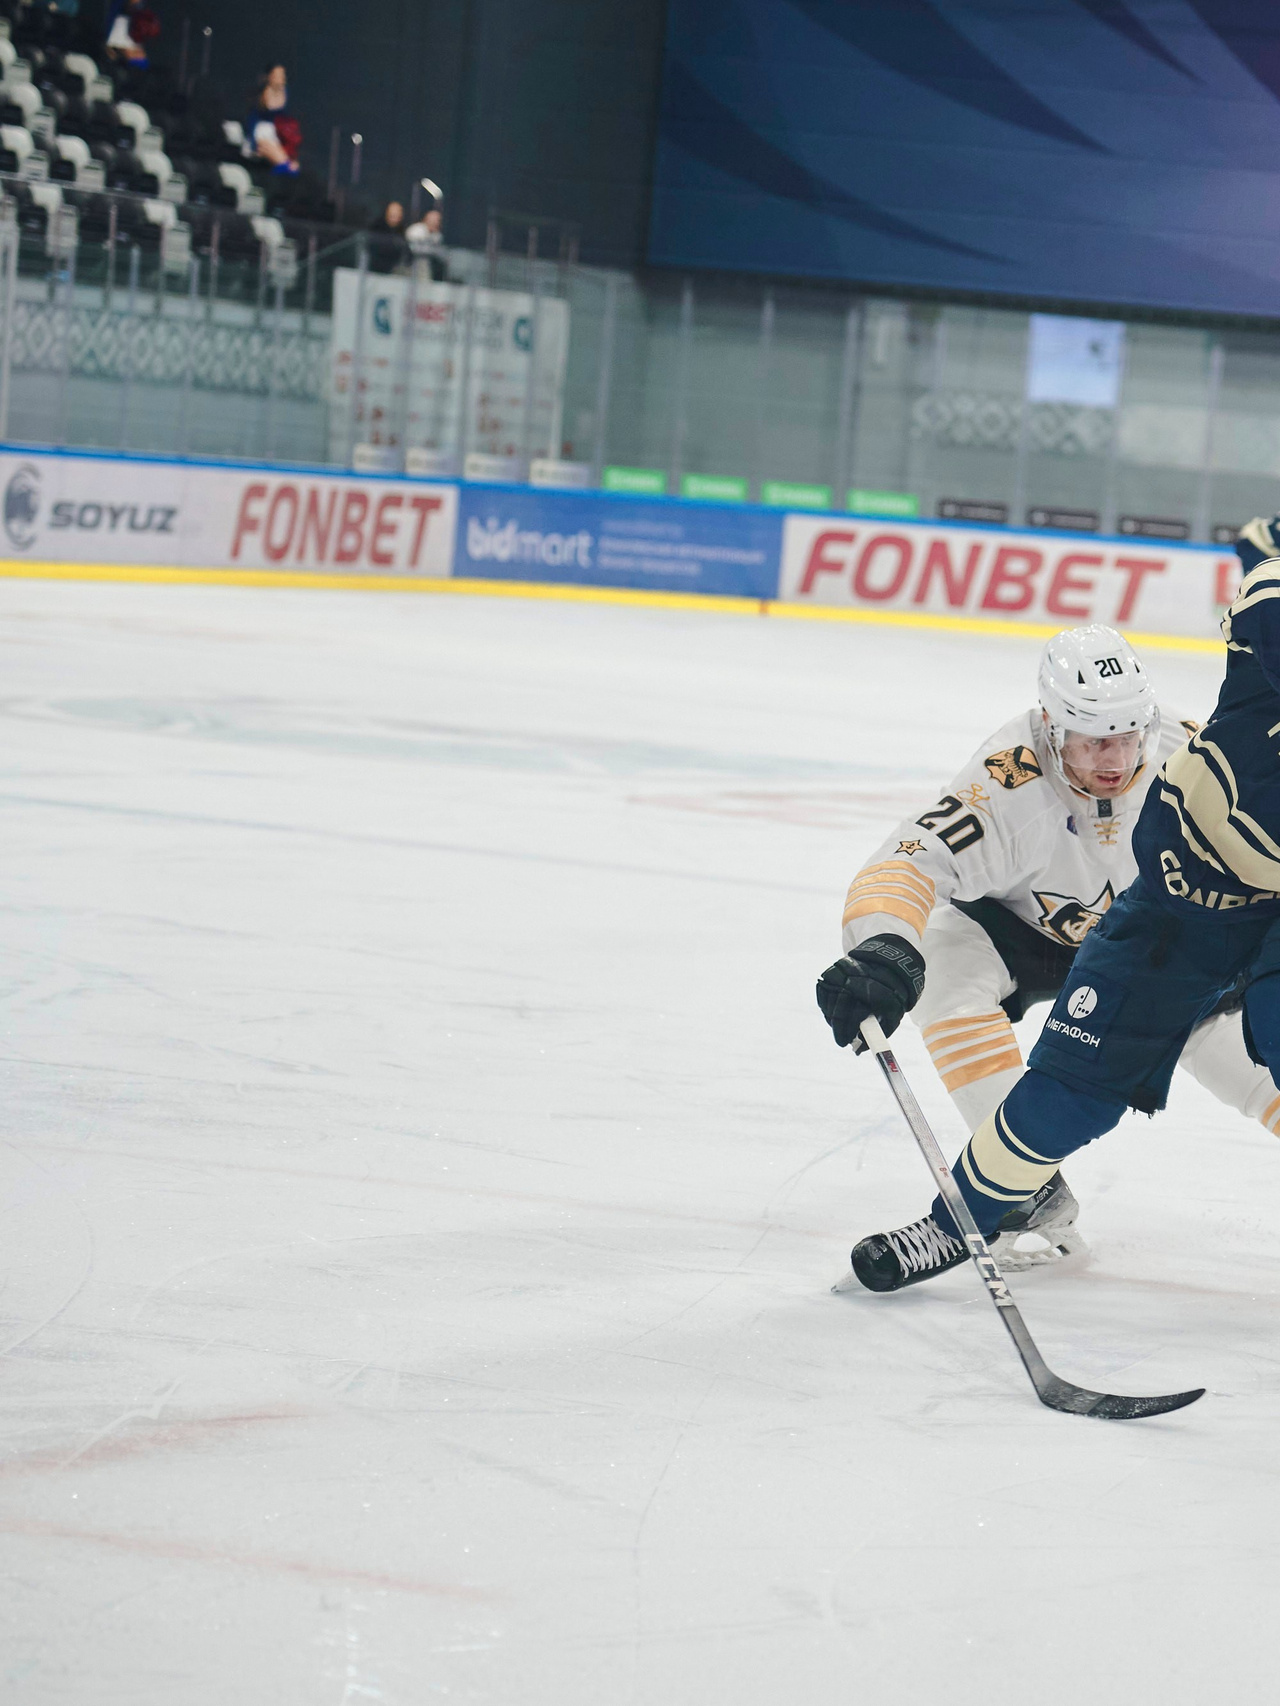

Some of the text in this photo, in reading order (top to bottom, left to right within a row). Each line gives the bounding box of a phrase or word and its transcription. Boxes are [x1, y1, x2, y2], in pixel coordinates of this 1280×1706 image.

[48, 500, 178, 534] SOYUZ
[229, 479, 443, 569] FONBET
[466, 516, 593, 568] bidmart
[798, 528, 1167, 624] FONBET
[1095, 657, 1123, 678] 20
[915, 795, 986, 857] 20
[855, 940, 926, 1000] BAUE
[1046, 1017, 1101, 1048] МЕГАФОН
[965, 1233, 1015, 1307] CCM
